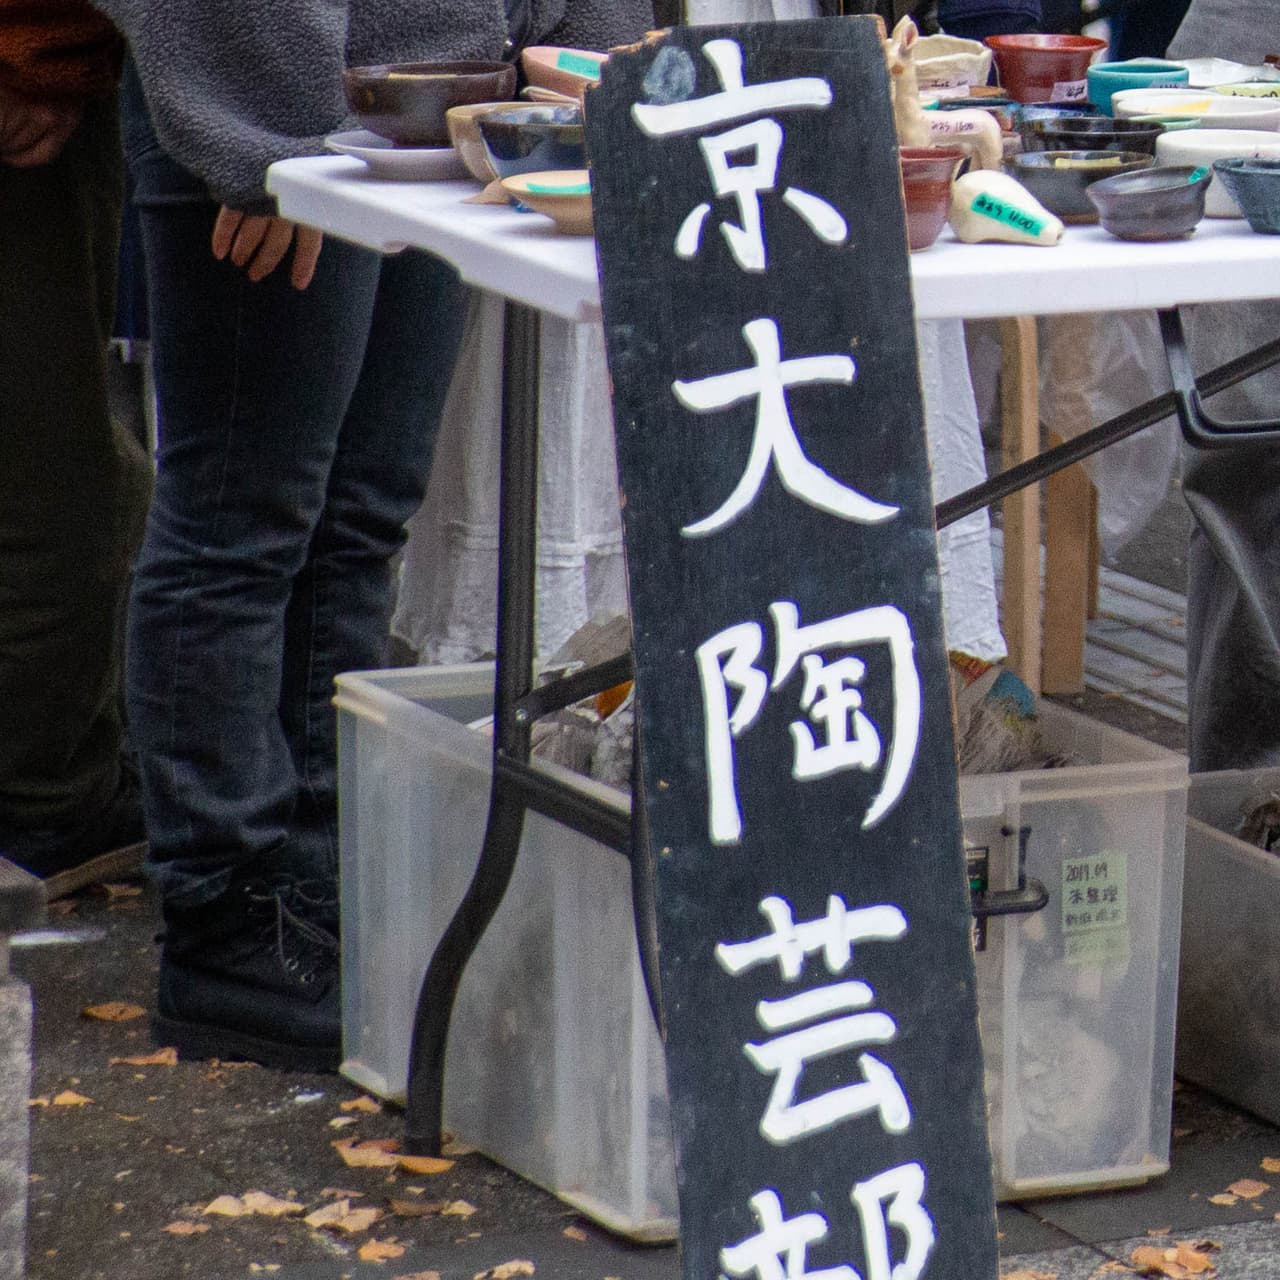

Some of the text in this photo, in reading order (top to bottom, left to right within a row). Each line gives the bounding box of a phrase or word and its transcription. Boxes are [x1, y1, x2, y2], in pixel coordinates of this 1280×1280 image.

[633, 38, 938, 1280] 京大陶芸部
